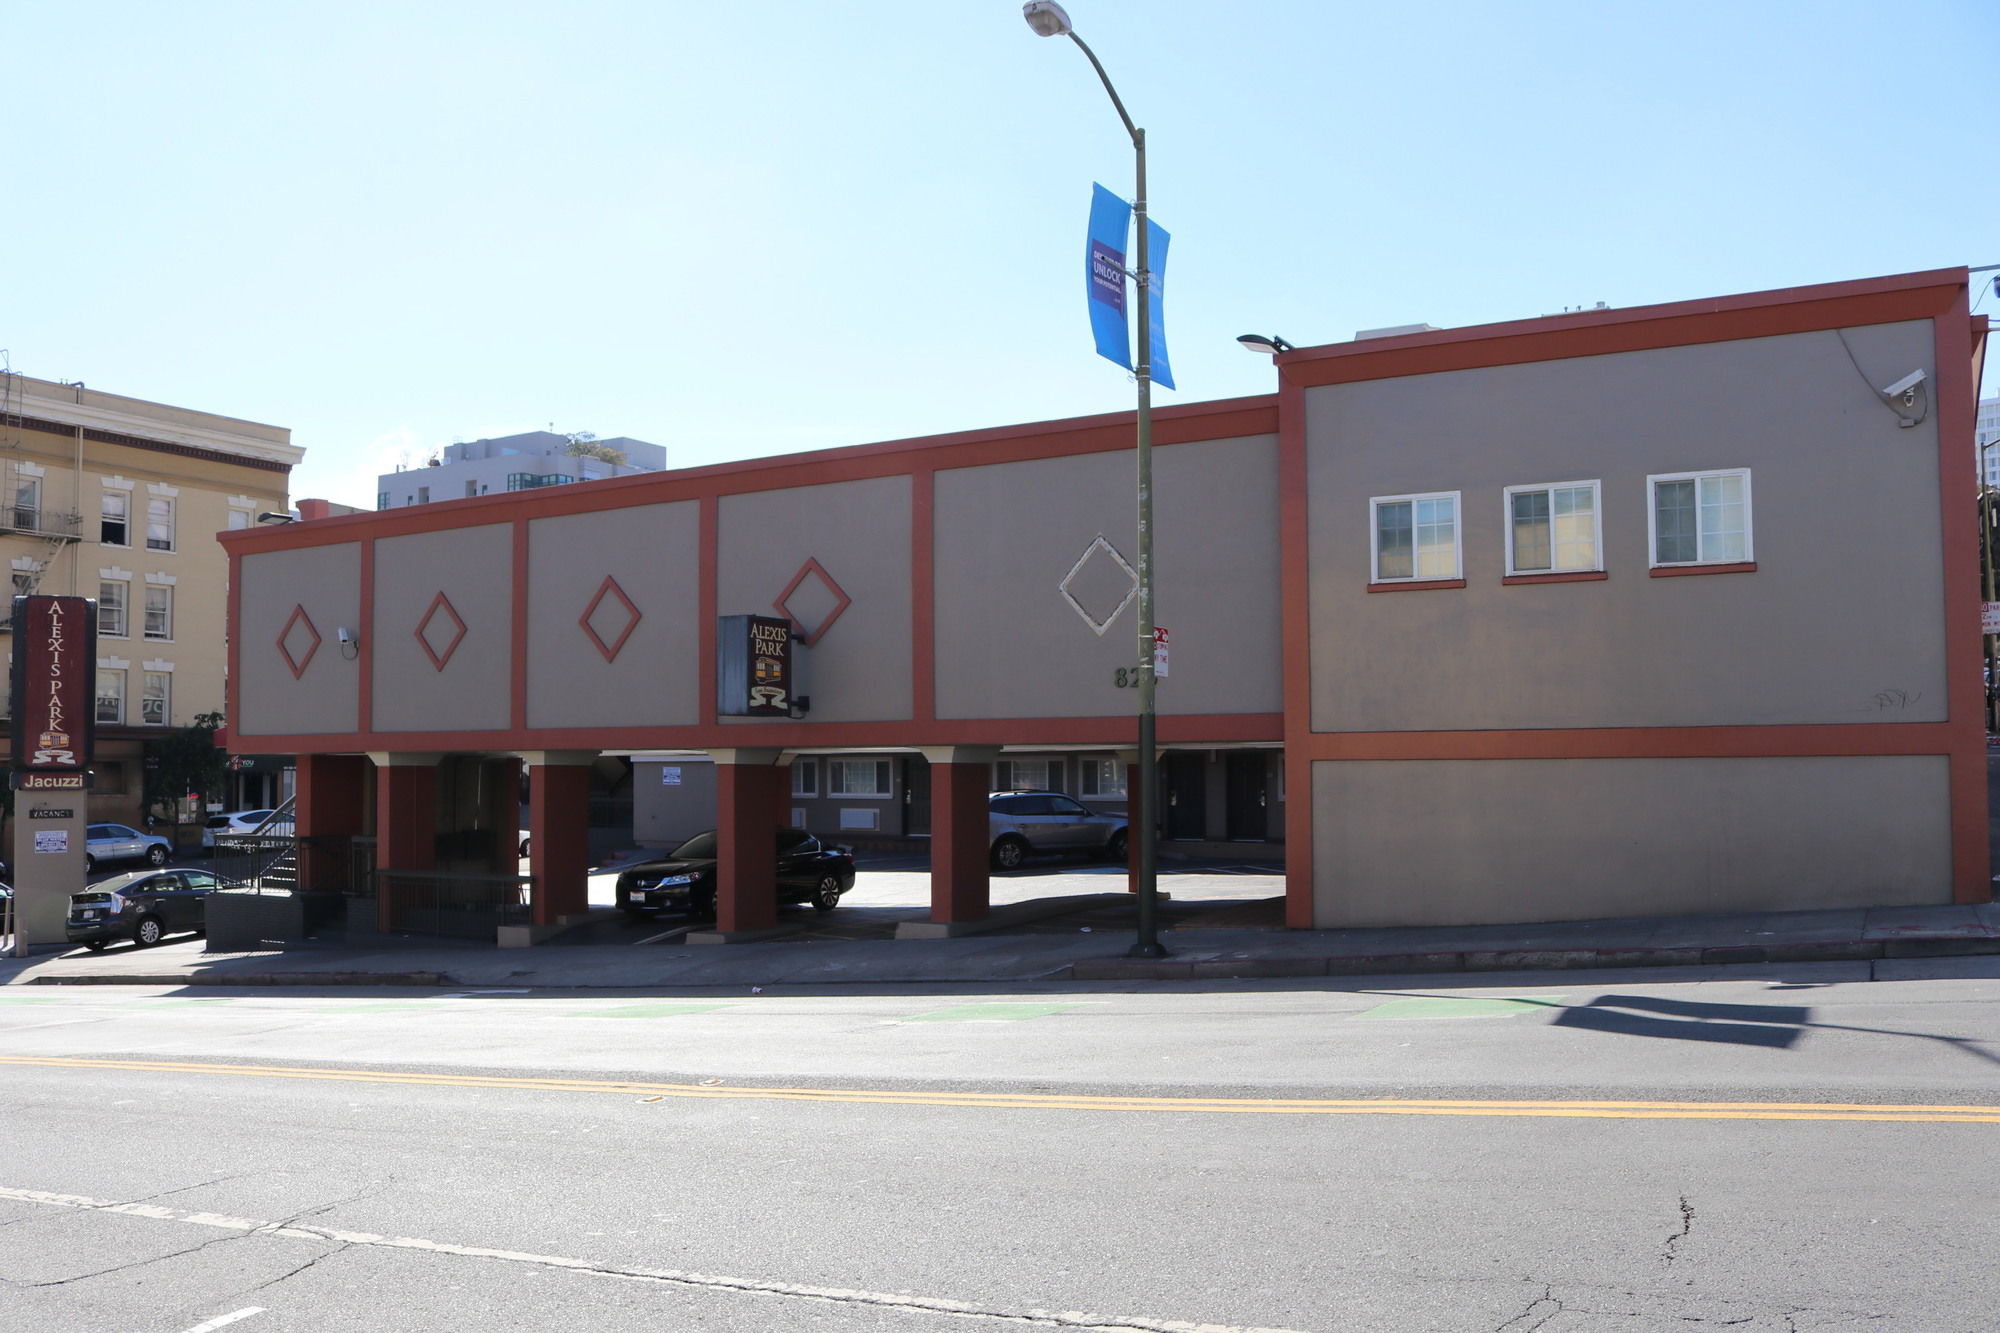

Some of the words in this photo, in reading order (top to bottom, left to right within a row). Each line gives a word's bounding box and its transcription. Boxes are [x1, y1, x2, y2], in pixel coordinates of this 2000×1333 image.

[1094, 261, 1120, 284] UNLOCK
[48, 600, 64, 677] ALEXIS
[750, 623, 787, 642] ALEXIS
[755, 638, 784, 656] PARK
[1115, 667, 1158, 688] 82
[48, 680, 65, 732] PARK
[25, 774, 83, 788] Jacuzzi
